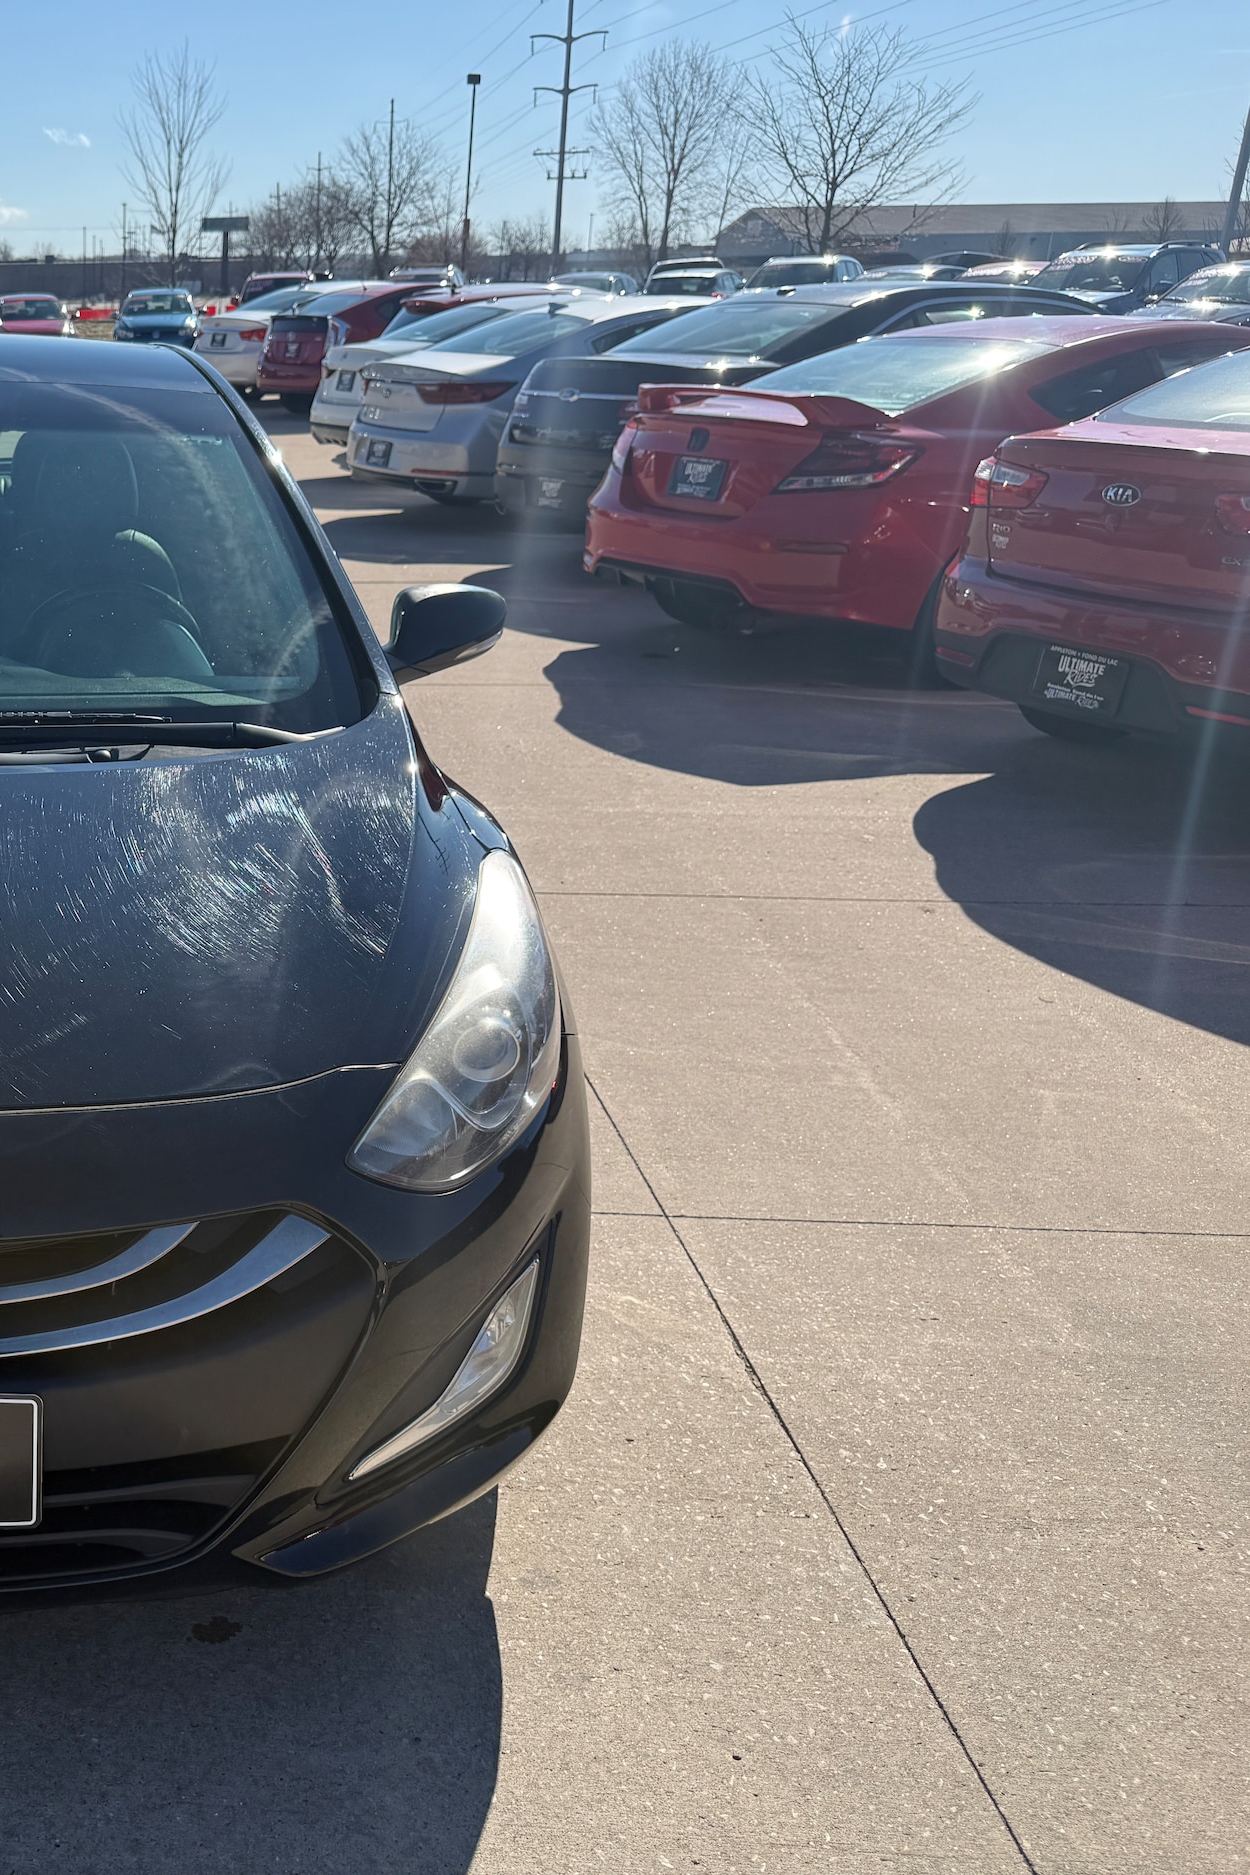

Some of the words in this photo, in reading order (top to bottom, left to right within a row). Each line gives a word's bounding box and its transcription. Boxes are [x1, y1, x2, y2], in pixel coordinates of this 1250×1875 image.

[1105, 487, 1133, 502] KIA
[992, 523, 1011, 533] RIO
[1050, 644, 1077, 656] APPLETON
[1058, 655, 1106, 675] ULTIMATE
